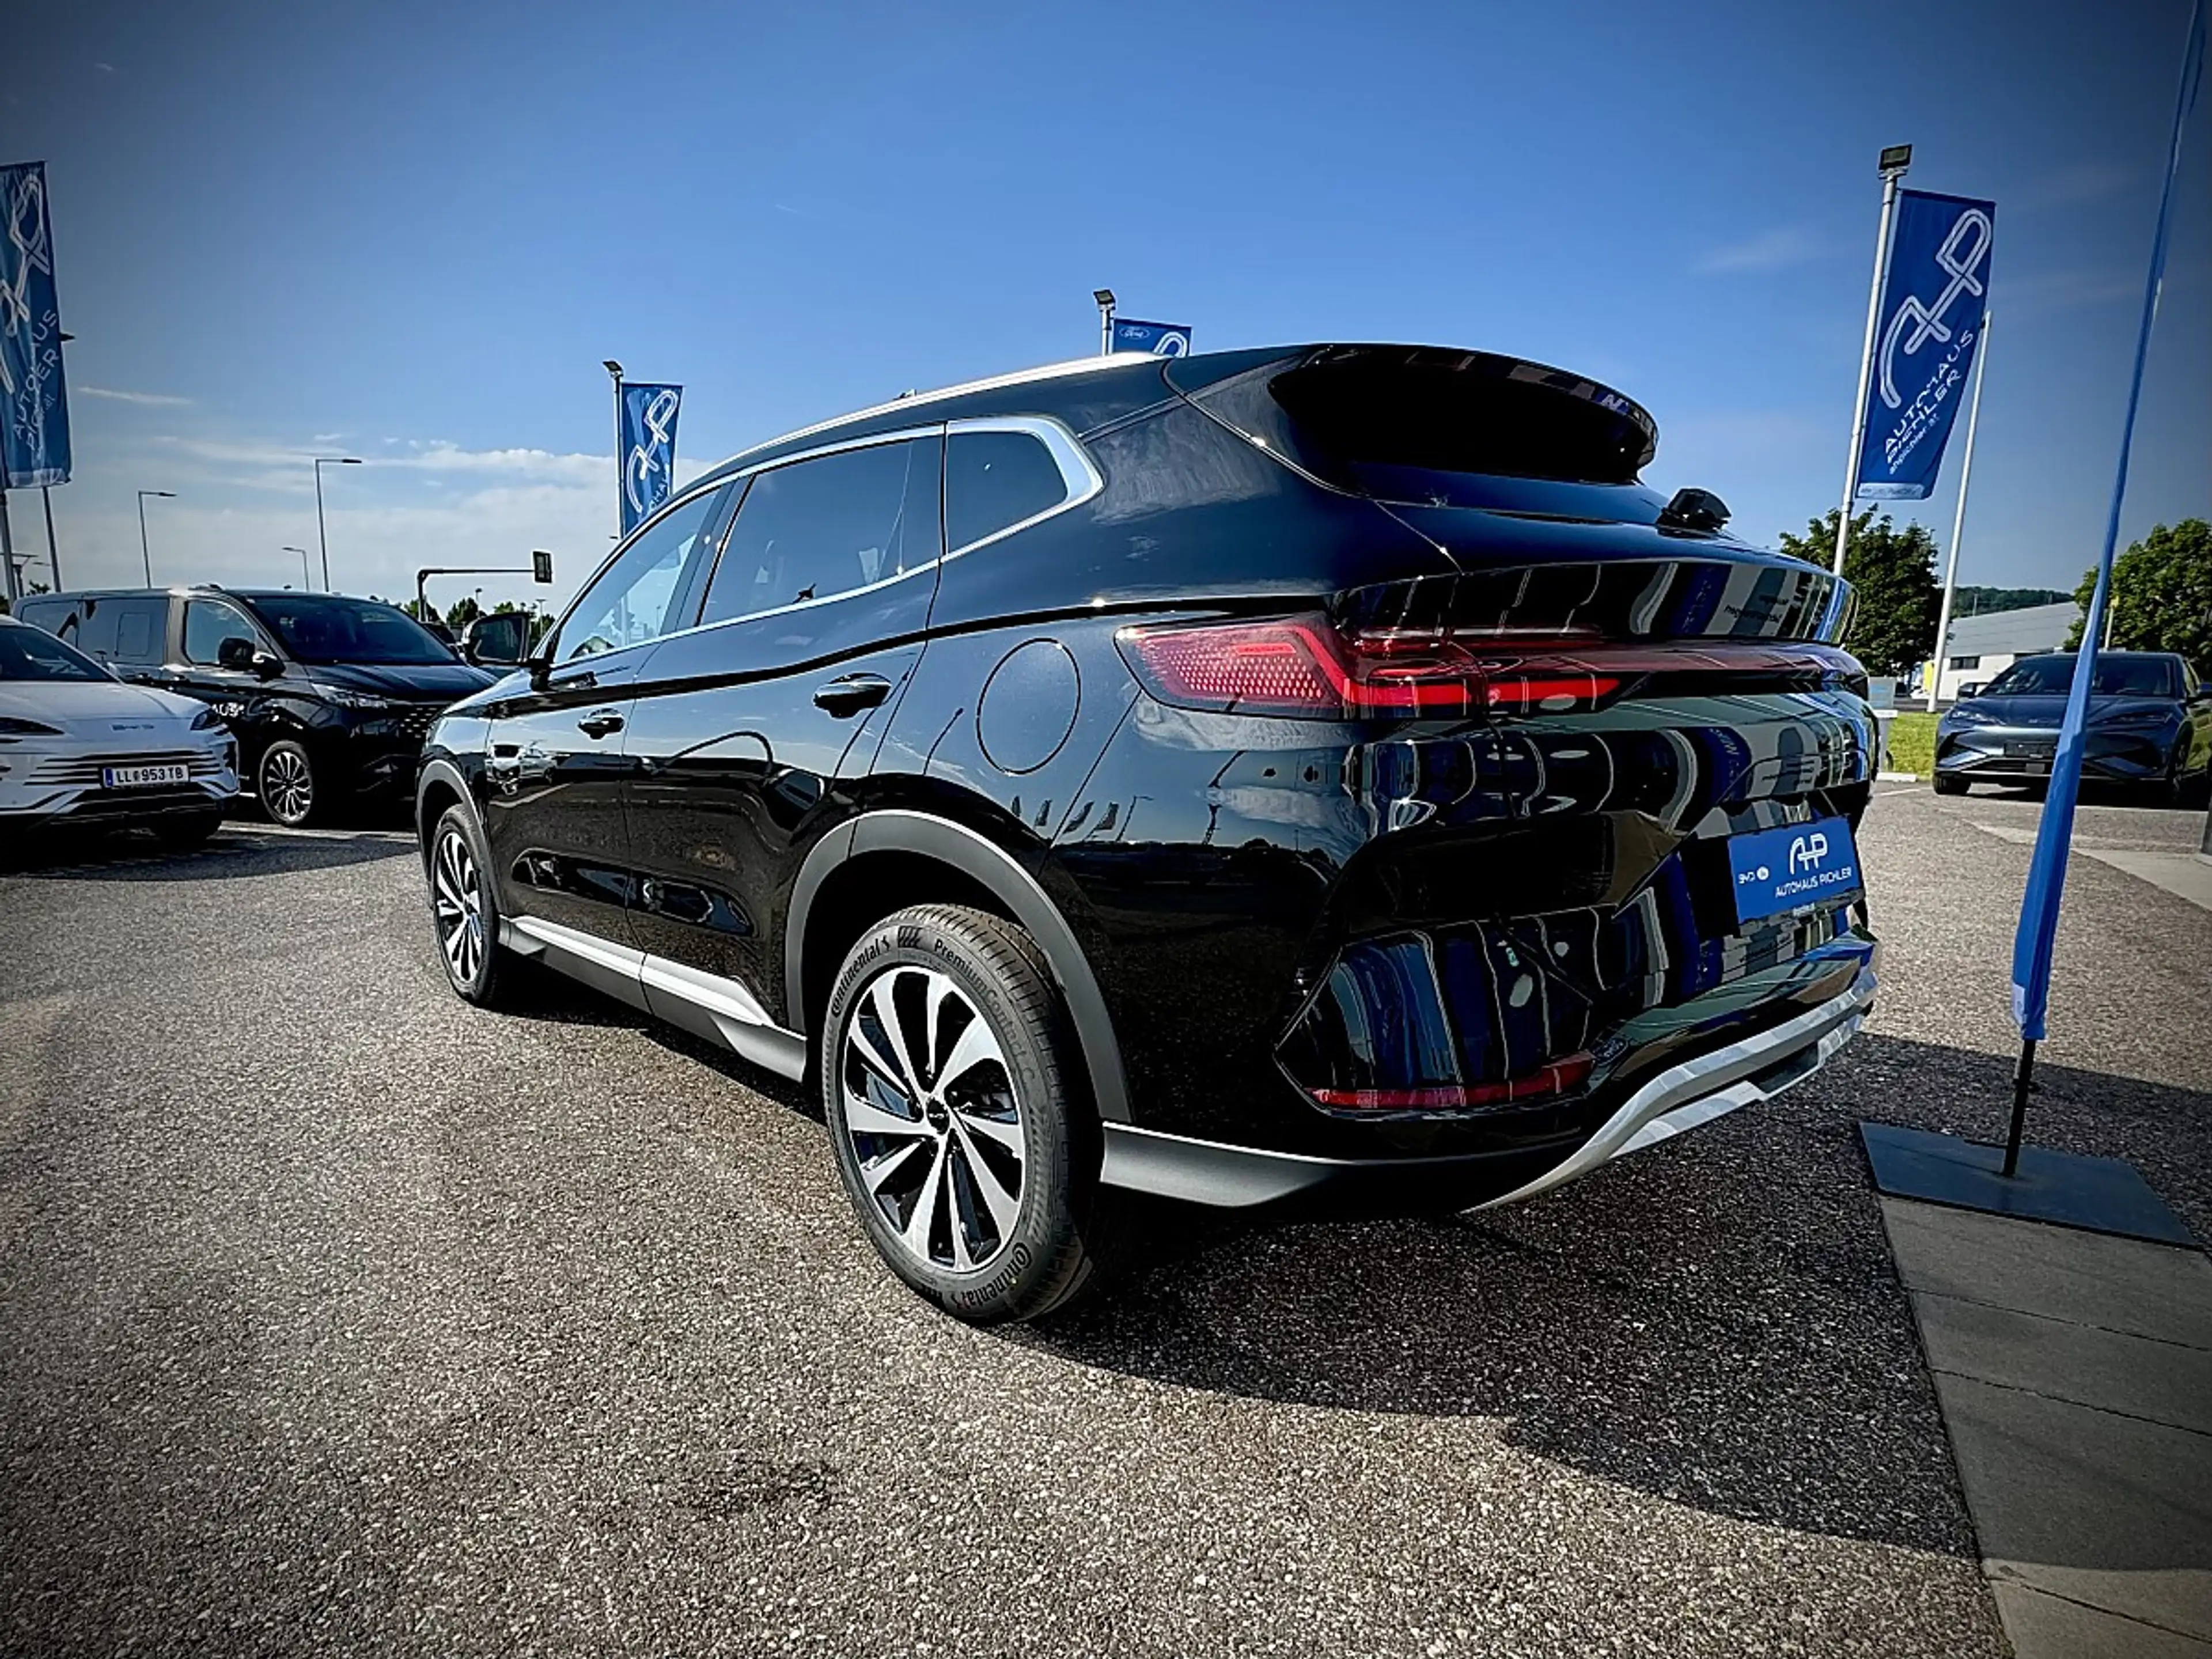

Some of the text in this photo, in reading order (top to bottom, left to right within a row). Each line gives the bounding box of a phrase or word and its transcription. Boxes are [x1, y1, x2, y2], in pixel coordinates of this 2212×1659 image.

[1886, 330, 1973, 453] AUTOHAUS
[1888, 369, 1961, 463] PICHLER
[116, 767, 183, 783] LL 953 TB
[1775, 866, 1852, 899] AUTOHAUS PICHLER
[832, 938, 881, 1018] Continental
[960, 1242, 1032, 1310] Continental
